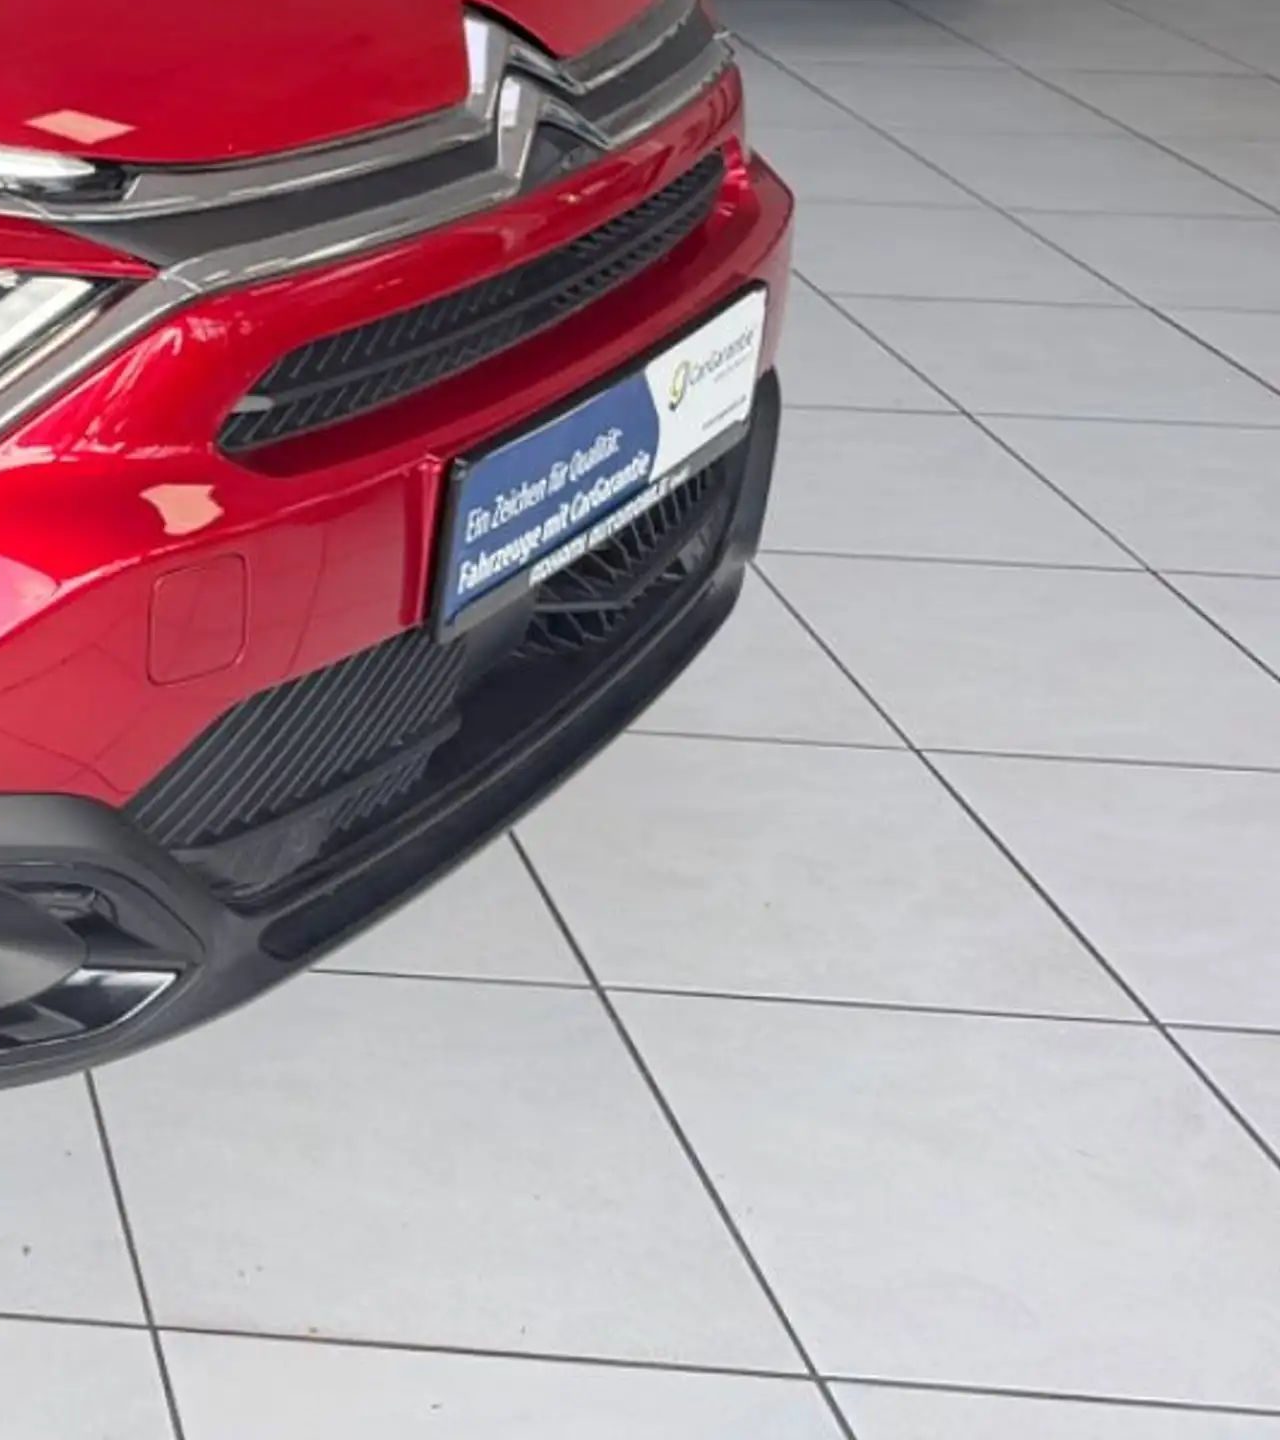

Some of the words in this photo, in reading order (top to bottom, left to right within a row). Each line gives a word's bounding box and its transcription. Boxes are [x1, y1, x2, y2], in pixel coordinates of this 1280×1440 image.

[465, 506, 491, 544] Ein
[490, 478, 548, 529] Zeichen
[547, 461, 569, 497] für
[457, 525, 542, 596] Fahrzeuge
[541, 502, 570, 542] mit
